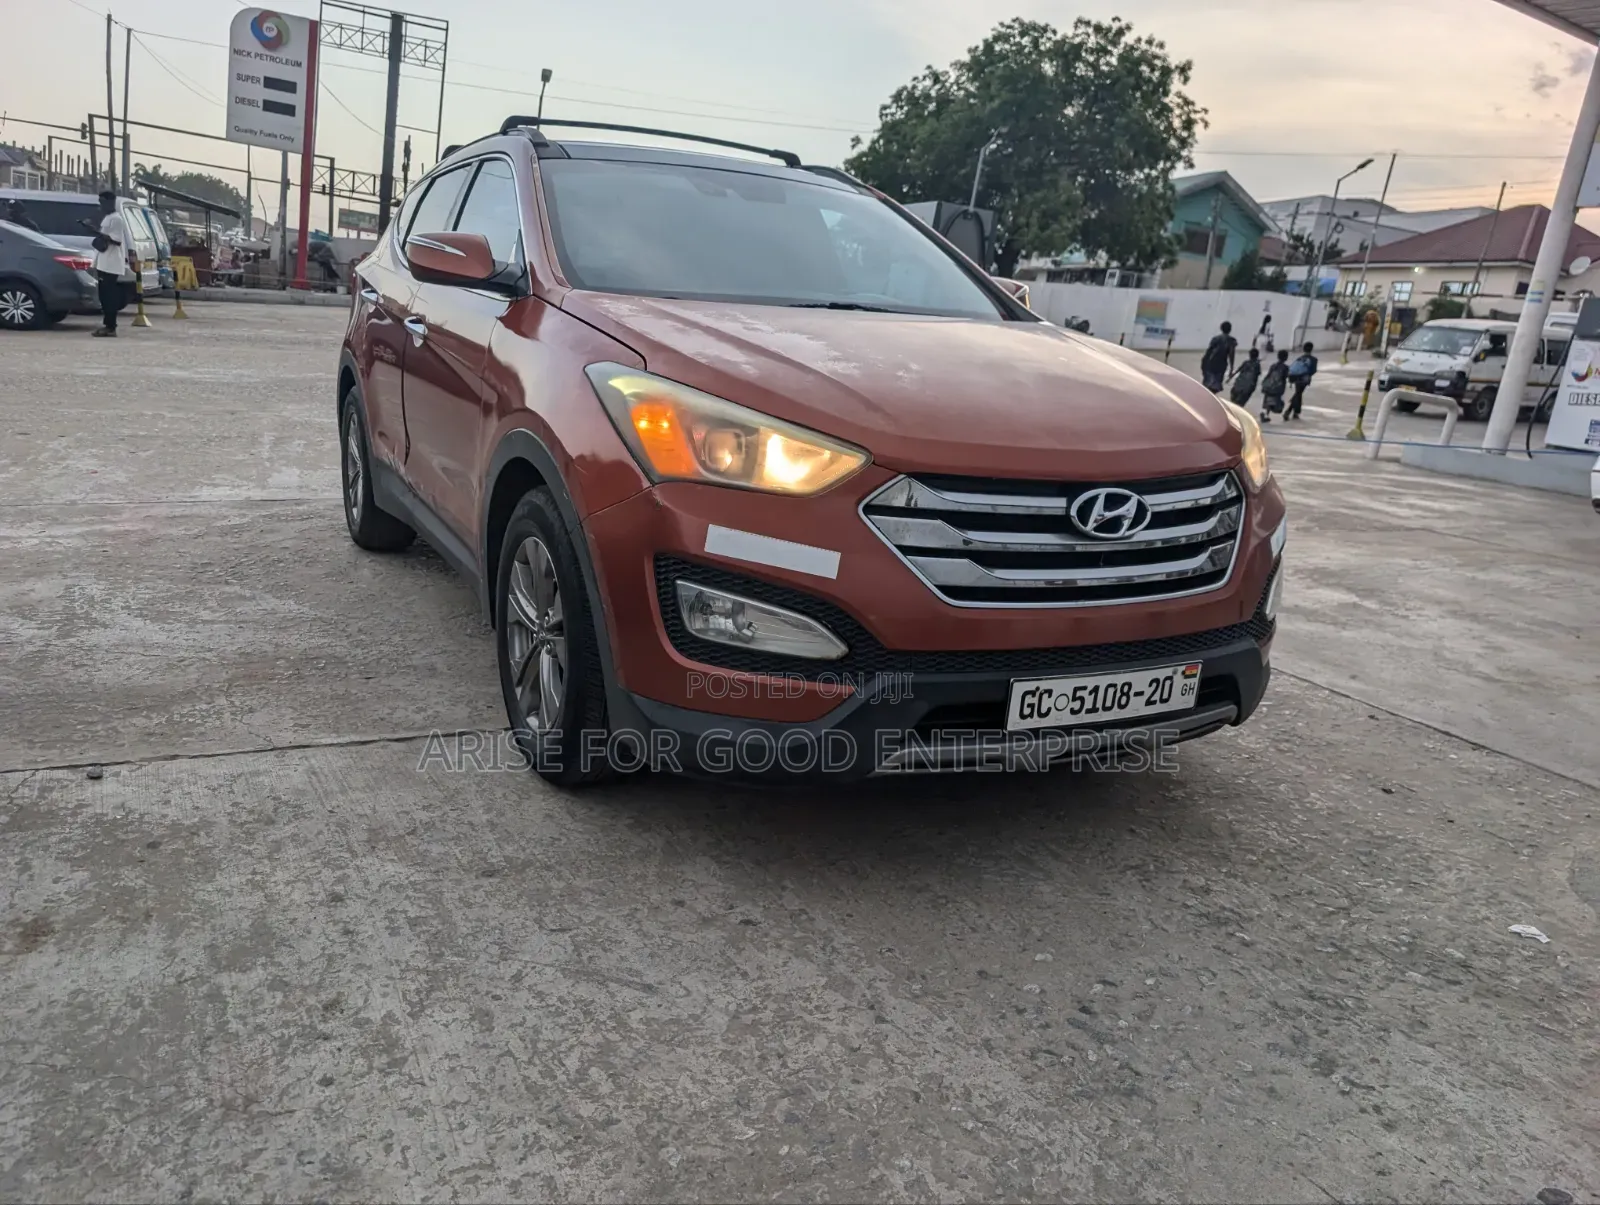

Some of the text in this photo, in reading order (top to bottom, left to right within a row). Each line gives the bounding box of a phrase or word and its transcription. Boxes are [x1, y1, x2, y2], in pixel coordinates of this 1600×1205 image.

[233, 47, 303, 68] NICK PETROLEUM
[236, 72, 261, 85] SUPER
[234, 95, 261, 109] DIESEL
[234, 125, 295, 144] Quality Fuels Only
[1568, 391, 1600, 407] DIESE
[1180, 682, 1196, 697] GH
